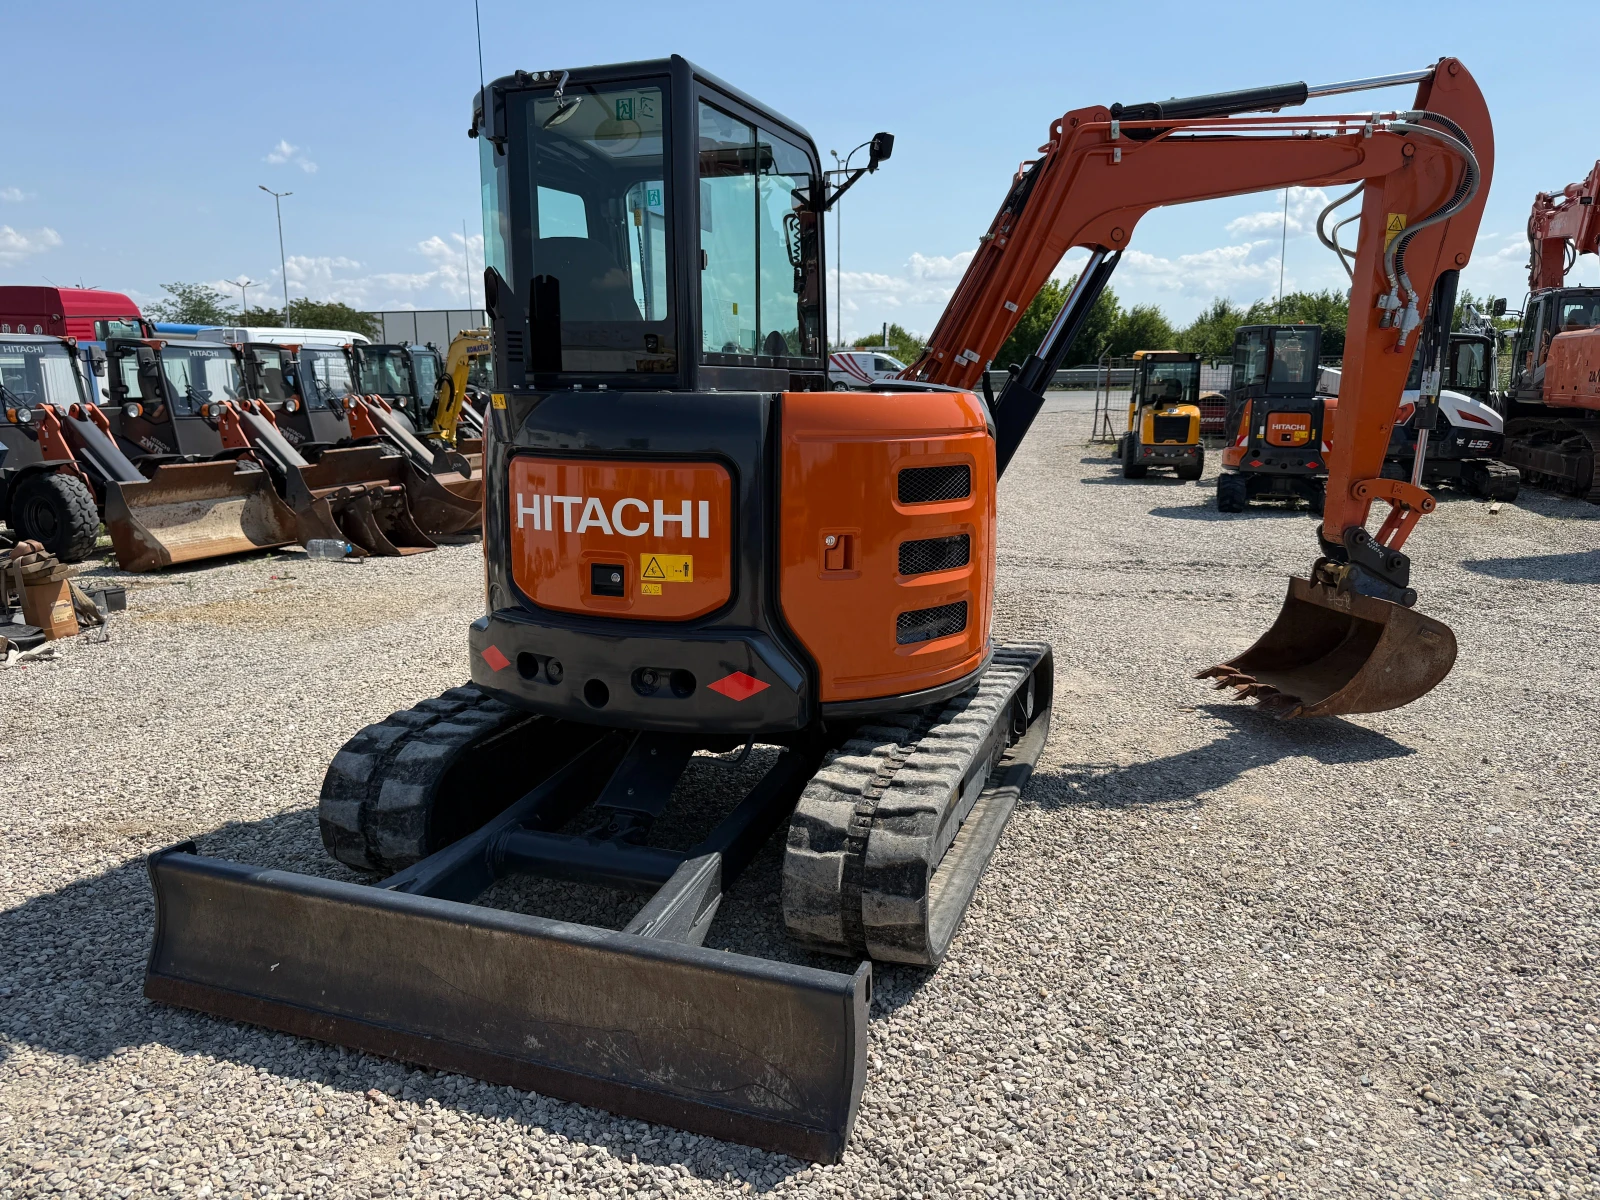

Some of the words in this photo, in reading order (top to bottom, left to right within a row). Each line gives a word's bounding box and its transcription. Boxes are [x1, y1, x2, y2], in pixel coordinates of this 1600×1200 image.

[3, 345, 44, 353] HITACHI
[466, 343, 489, 353] KOMATSU
[188, 349, 220, 357] HITACHI
[1271, 423, 1306, 431] HITACHI
[140, 435, 164, 455] ZW75
[516, 492, 710, 539] HITACHI
